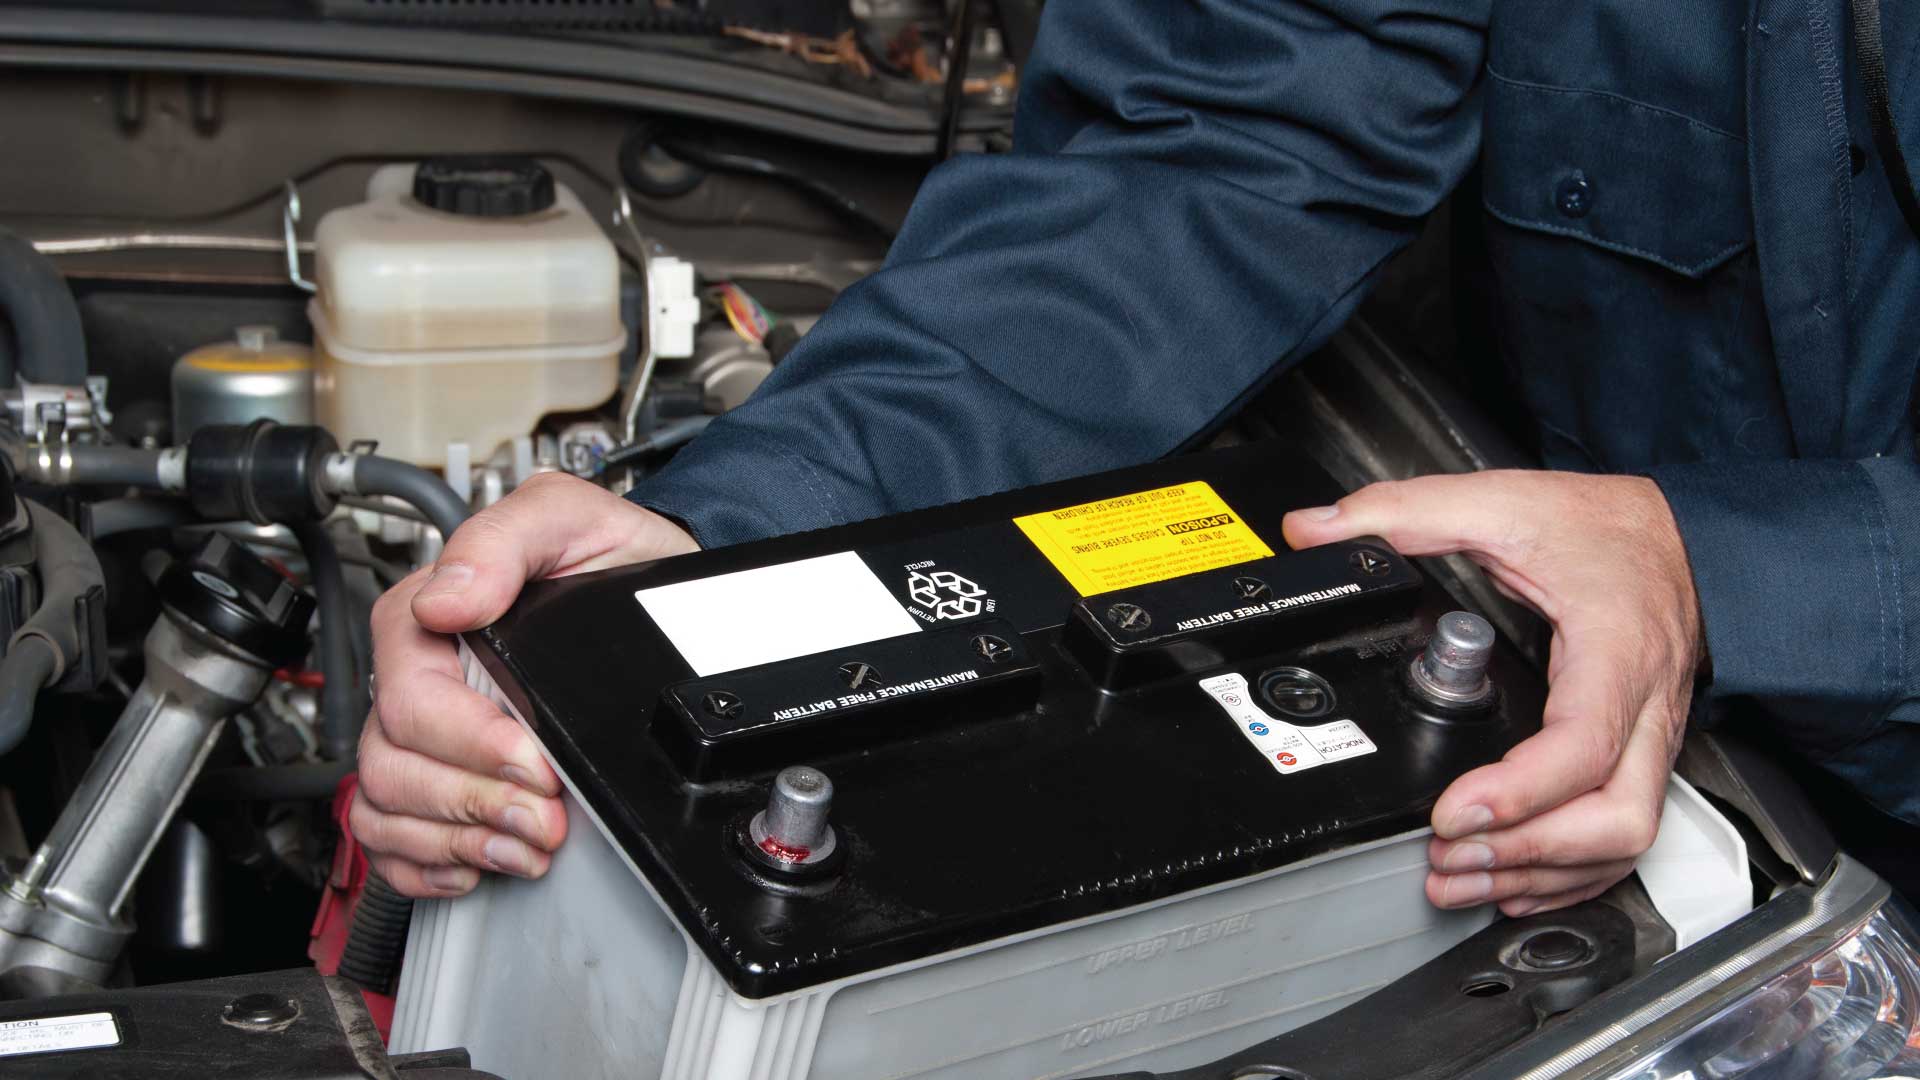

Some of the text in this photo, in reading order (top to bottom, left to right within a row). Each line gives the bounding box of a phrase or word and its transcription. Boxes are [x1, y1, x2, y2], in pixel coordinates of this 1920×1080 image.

[1148, 491, 1165, 501] OUT
[1167, 488, 1185, 497] KEEP
[1107, 498, 1135, 509] REACH
[1136, 495, 1147, 504] OF
[1053, 506, 1094, 520] CHILDREN
[1096, 503, 1107, 512] OF
[1169, 516, 1220, 534] POISON
[1132, 528, 1165, 541] CAUSES
[1195, 533, 1213, 543] NOT
[1213, 530, 1227, 539] DO
[1103, 535, 1132, 548] SEVERE
[1181, 537, 1194, 546] TIP
[1071, 542, 1101, 554] BURNS
[904, 560, 936, 571] RECYCLE
[986, 599, 996, 612] LEAD
[1176, 583, 1362, 631] MAINTENANCE FREE BATTERY
[907, 606, 937, 623] RETURN
[774, 670, 980, 721] MAINTENANCE FREE BATTERY
[1320, 739, 1365, 754] INDICATOR
[1087, 914, 1254, 974] UPPER LEVEL
[0, 1021, 39, 1029] TION
[1061, 990, 1230, 1050] LOWER LEVEL
